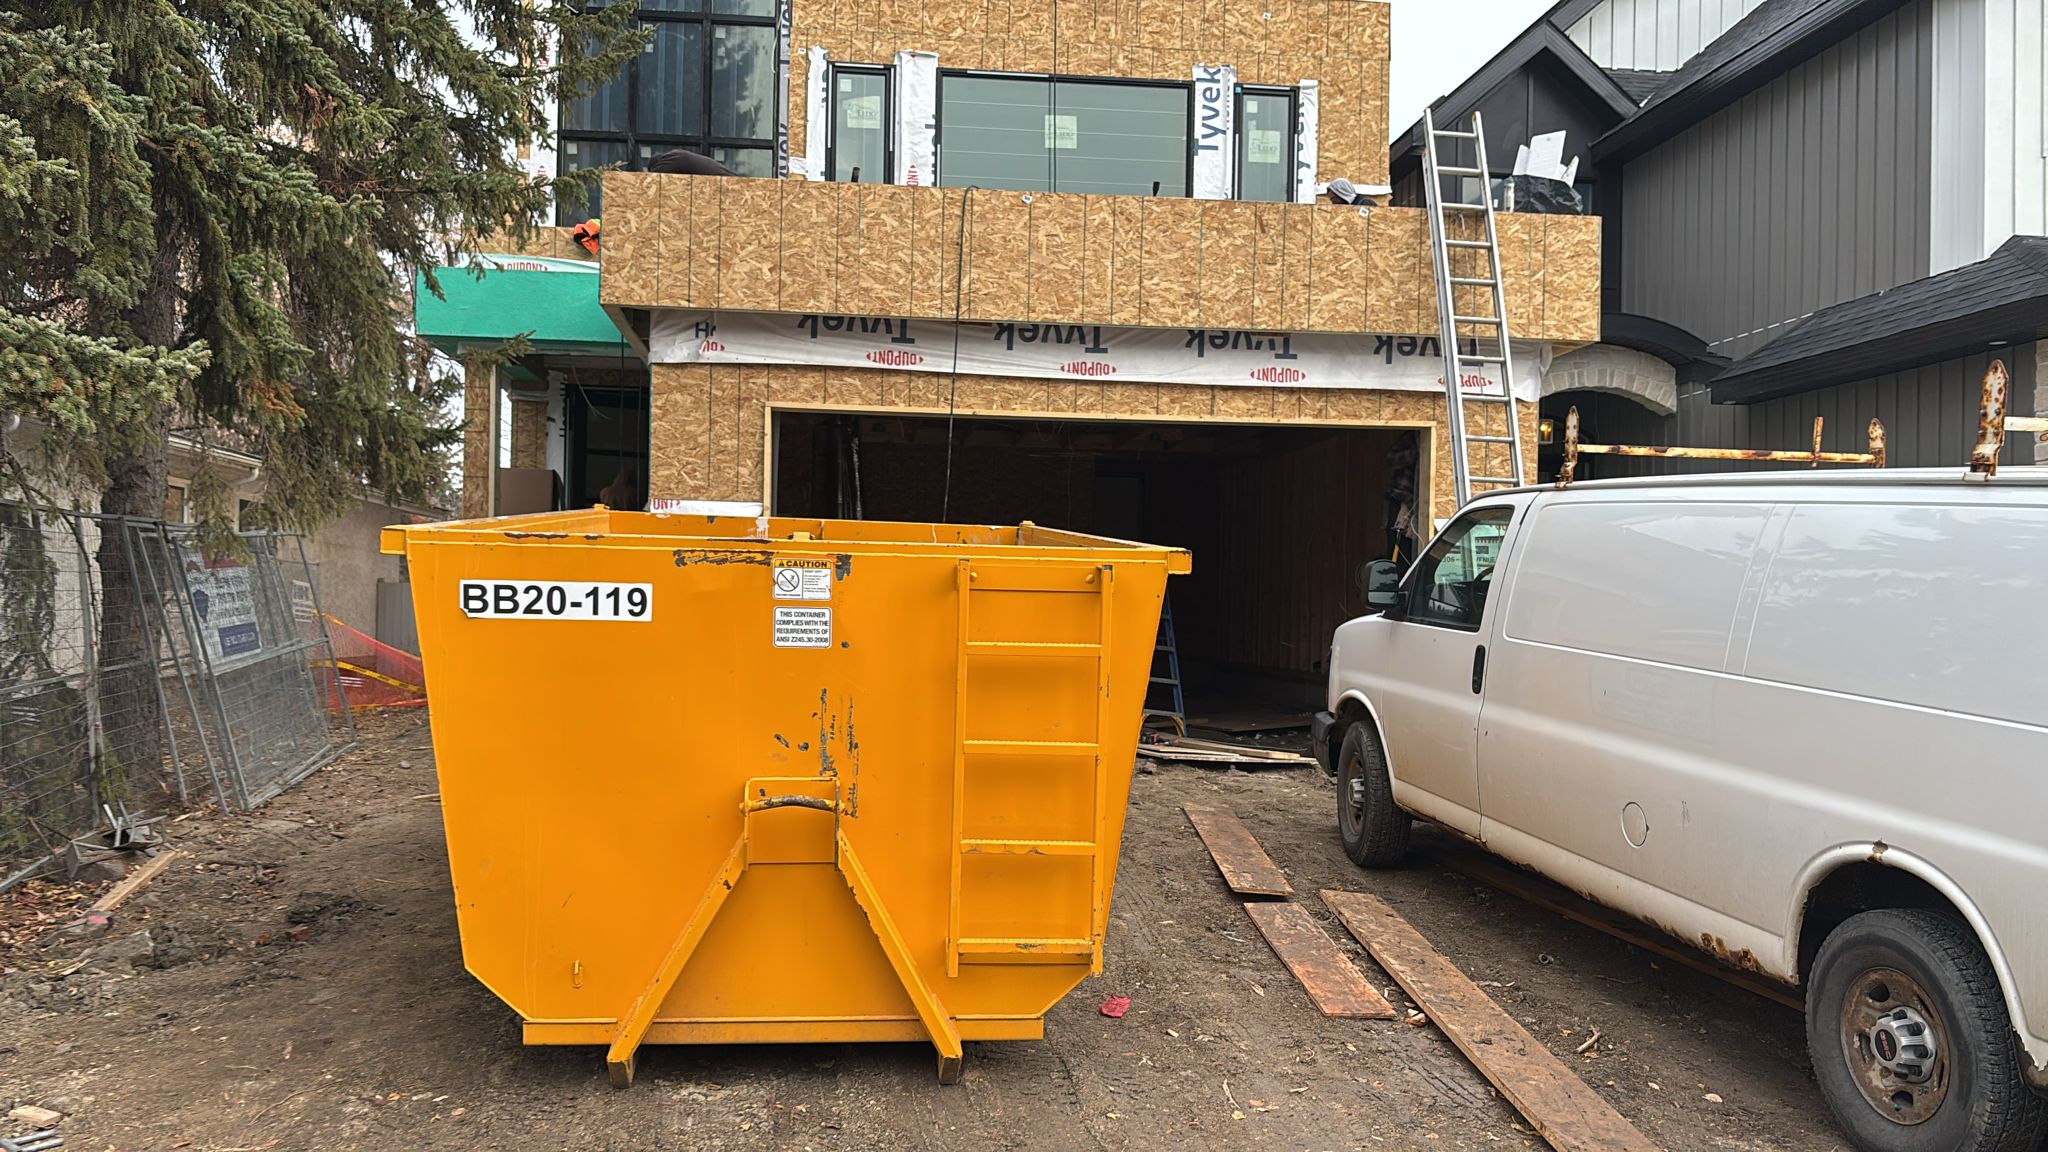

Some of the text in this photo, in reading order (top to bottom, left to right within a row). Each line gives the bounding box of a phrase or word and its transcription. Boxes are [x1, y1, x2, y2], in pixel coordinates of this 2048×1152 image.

[1192, 66, 1227, 156] Tyvek
[872, 350, 917, 366] DUPONT
[1068, 361, 1110, 376] DUPONT
[1257, 367, 1300, 383] DUPONT
[786, 560, 828, 568] CAUTION
[463, 584, 648, 617] BB20-119
